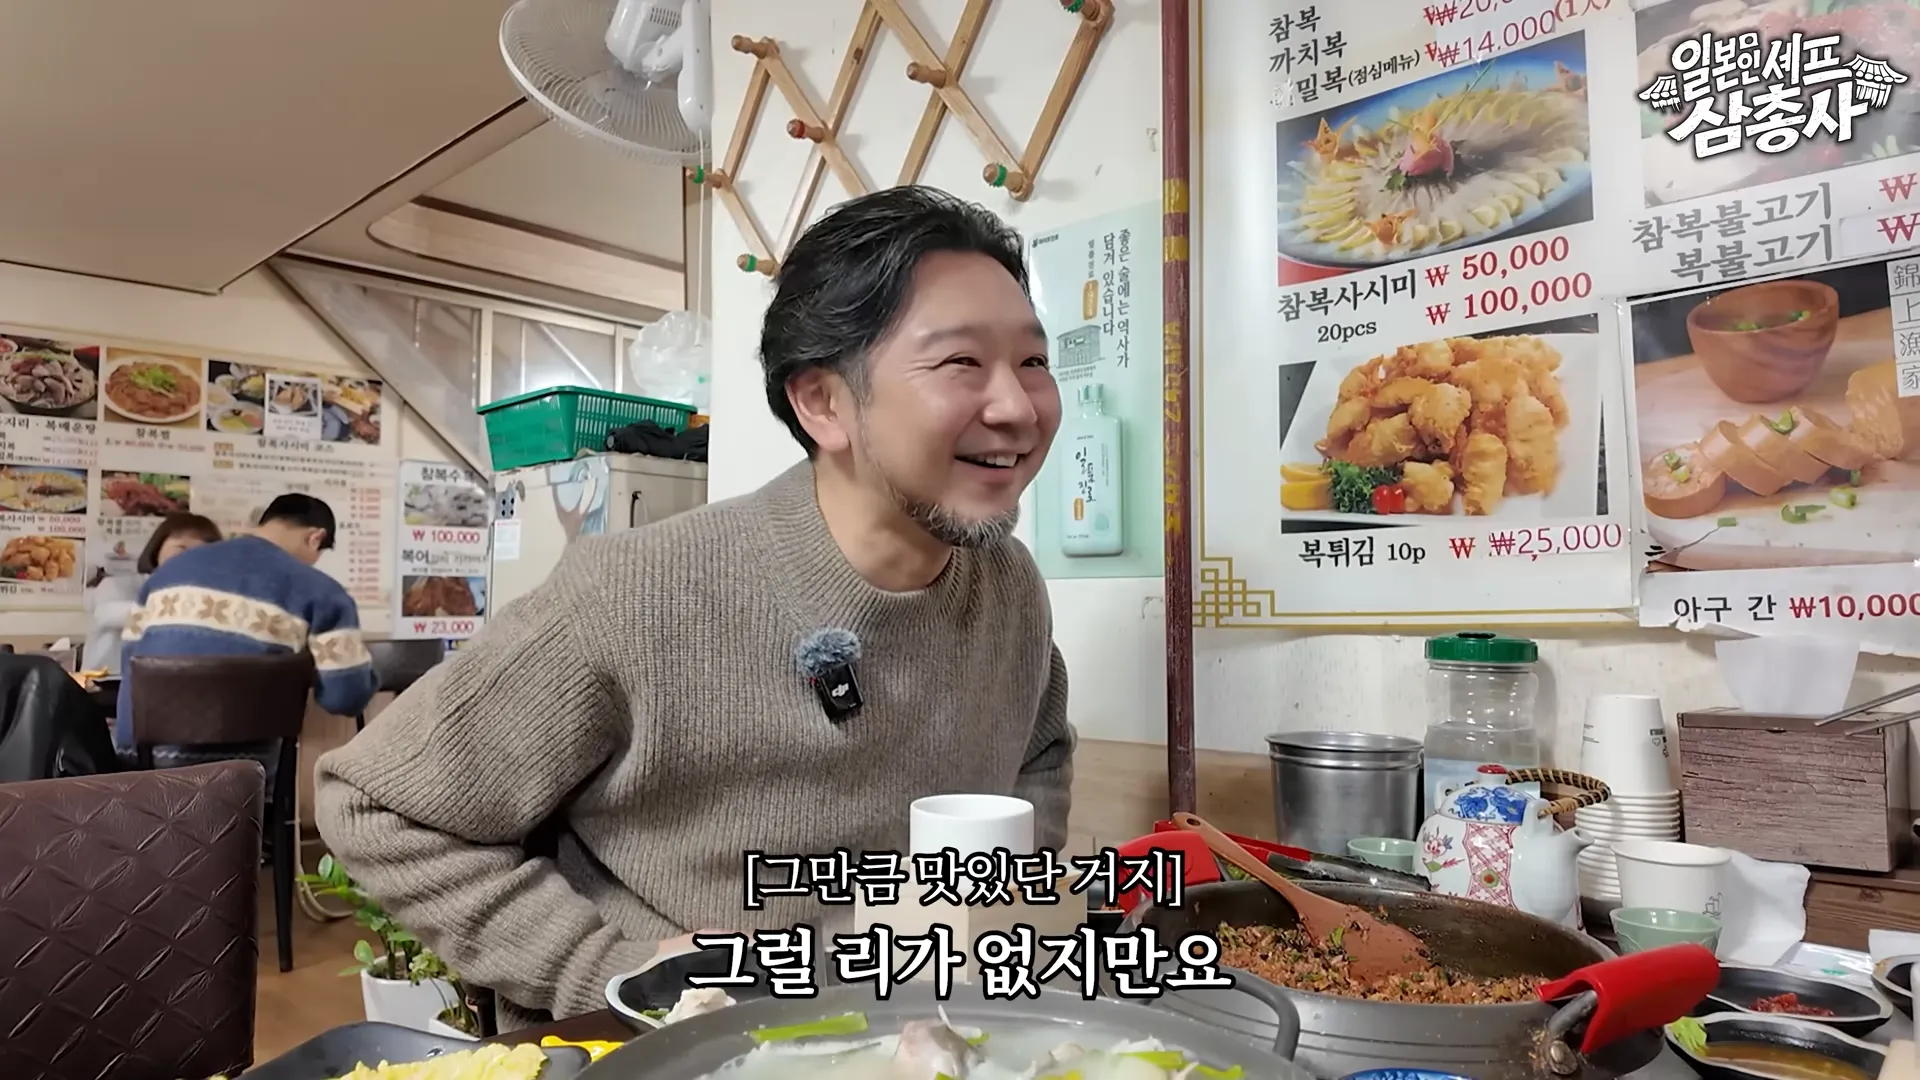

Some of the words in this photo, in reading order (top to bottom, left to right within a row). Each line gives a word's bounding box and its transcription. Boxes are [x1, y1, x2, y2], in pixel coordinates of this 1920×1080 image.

[1269, 5, 1321, 43] 참복
[1269, 31, 1348, 75] 까치복
[1632, 182, 1832, 253] 참복불고기
[1103, 232, 1116, 265] 담겨
[1119, 229, 1131, 263] 좋은
[1670, 224, 1832, 283] 복불고기
[1102, 270, 1115, 336] 있습니다
[1117, 265, 1130, 316] 술에는
[1277, 269, 1416, 322] 참복사시미
[1462, 235, 1570, 280] 50,000
[1317, 320, 1377, 343] 20pcs
[1464, 271, 1592, 319] 100,000
[1116, 318, 1130, 369] 역사가
[1299, 536, 1374, 568] 복튀김
[1388, 542, 1426, 564] 10p
[1674, 596, 1732, 623] 아구
[1747, 595, 1777, 621] 간
